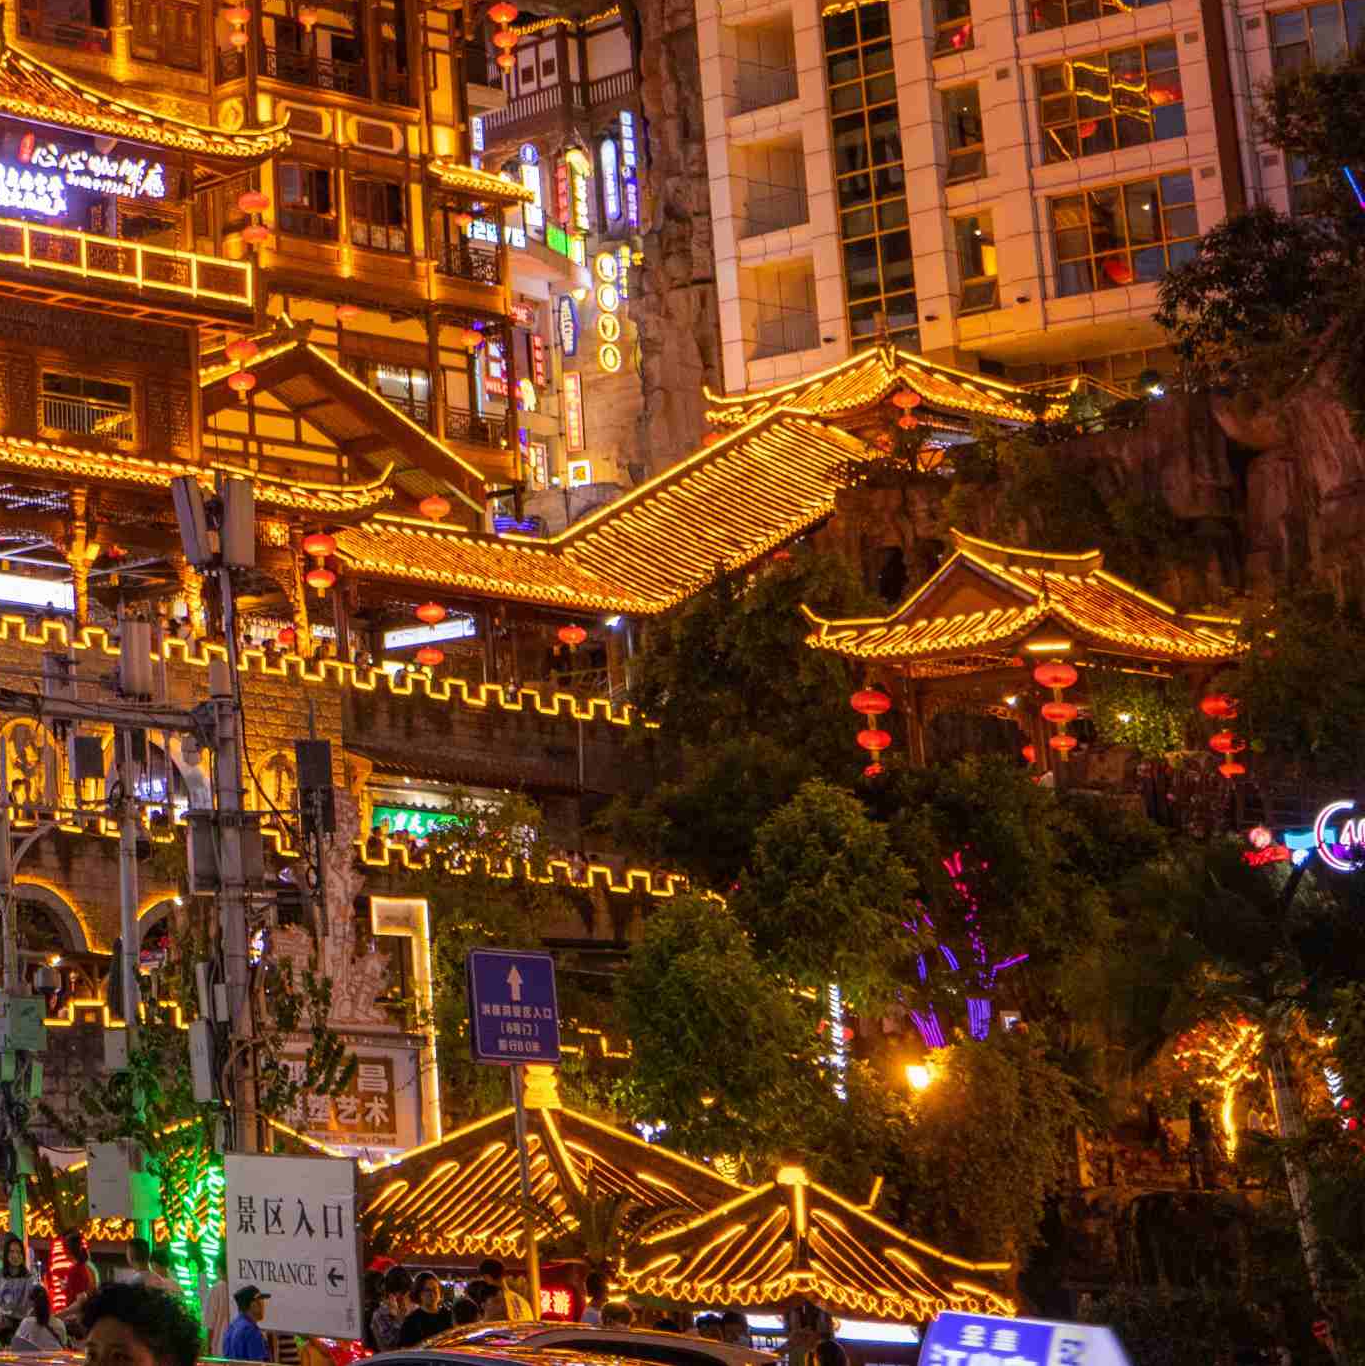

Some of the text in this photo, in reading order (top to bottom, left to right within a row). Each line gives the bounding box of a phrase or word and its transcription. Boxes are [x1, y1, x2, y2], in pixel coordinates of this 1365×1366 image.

[236, 1194, 344, 1239] 景区入口
[237, 1258, 318, 1287] ENTRANCE
